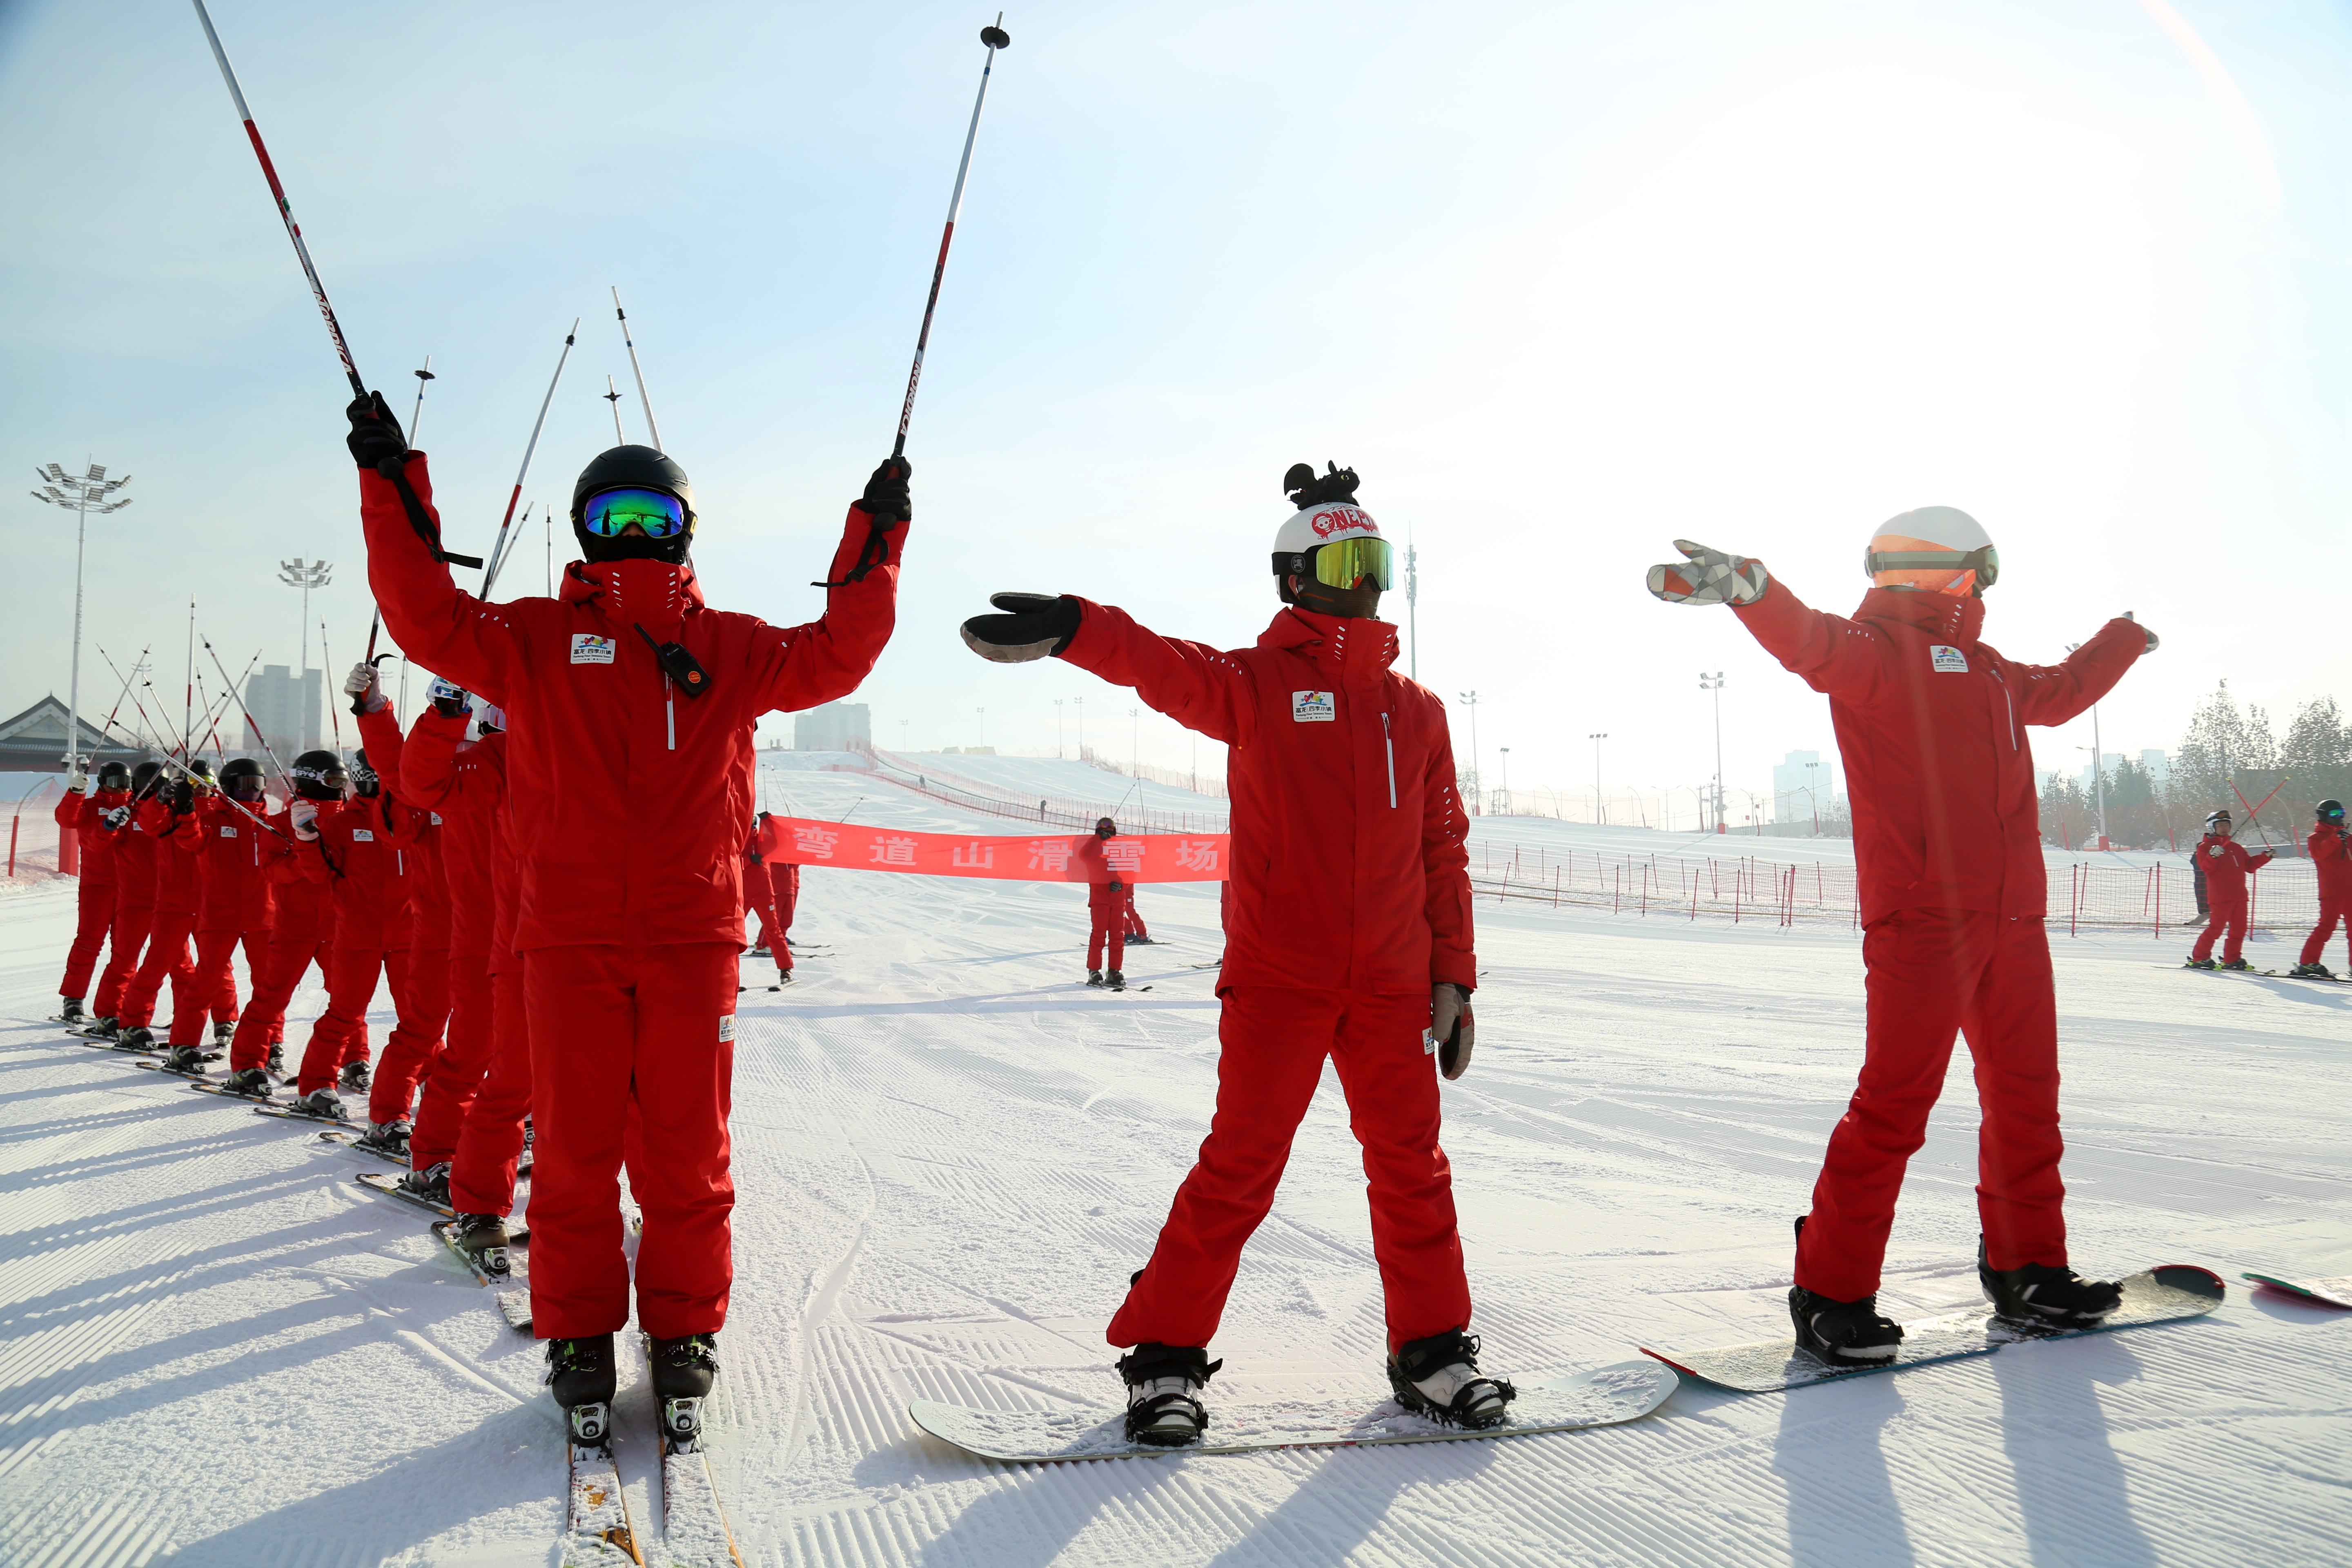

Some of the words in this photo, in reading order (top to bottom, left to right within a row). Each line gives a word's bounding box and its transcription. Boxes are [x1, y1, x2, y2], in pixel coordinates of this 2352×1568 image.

[898, 361, 922, 436] NORDICA
[792, 826, 1219, 873] 弯道山滑雪场
